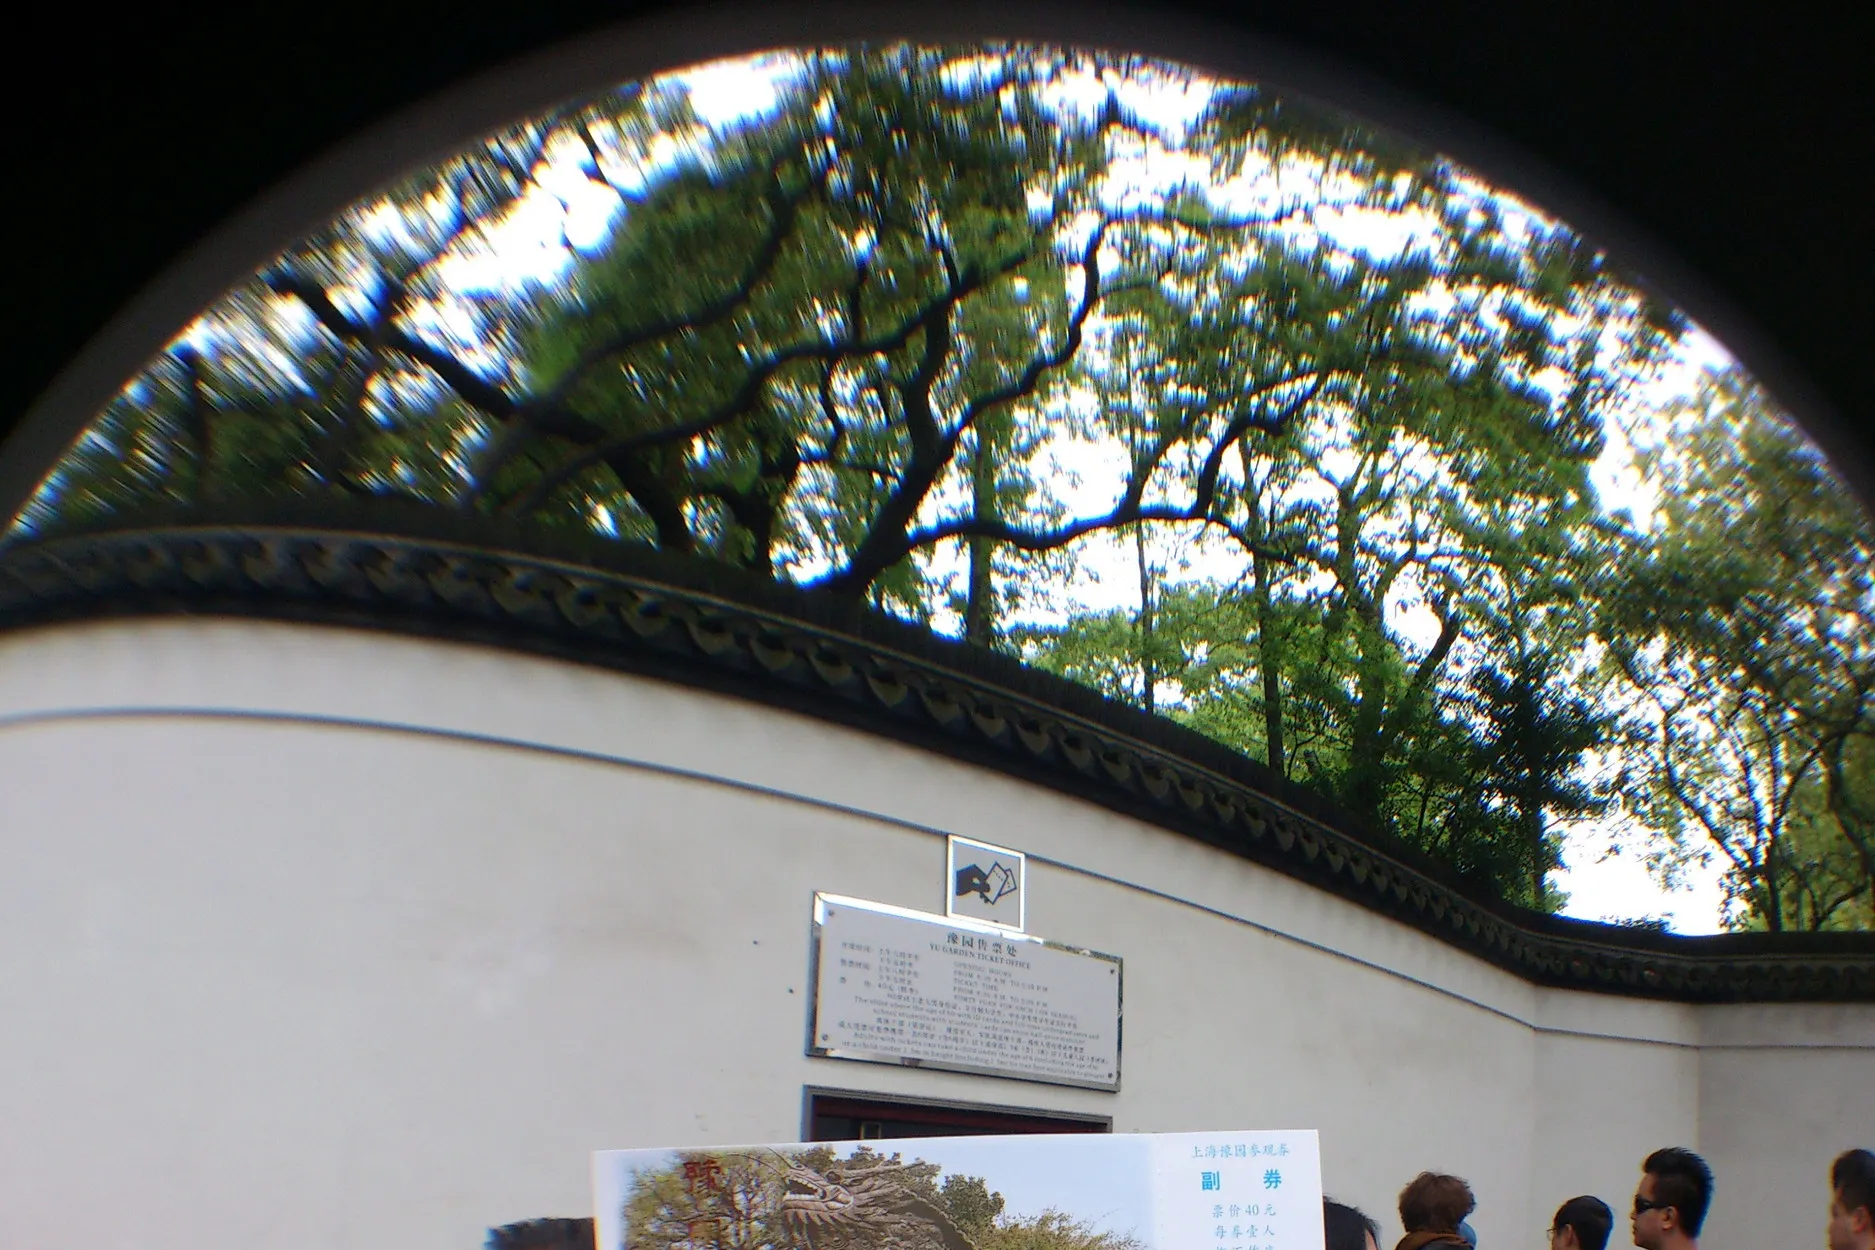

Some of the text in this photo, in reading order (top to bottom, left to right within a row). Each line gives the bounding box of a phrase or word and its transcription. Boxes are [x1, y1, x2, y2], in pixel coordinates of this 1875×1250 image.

[930, 943, 1030, 970] YU GARDEN TICKET OFFICE
